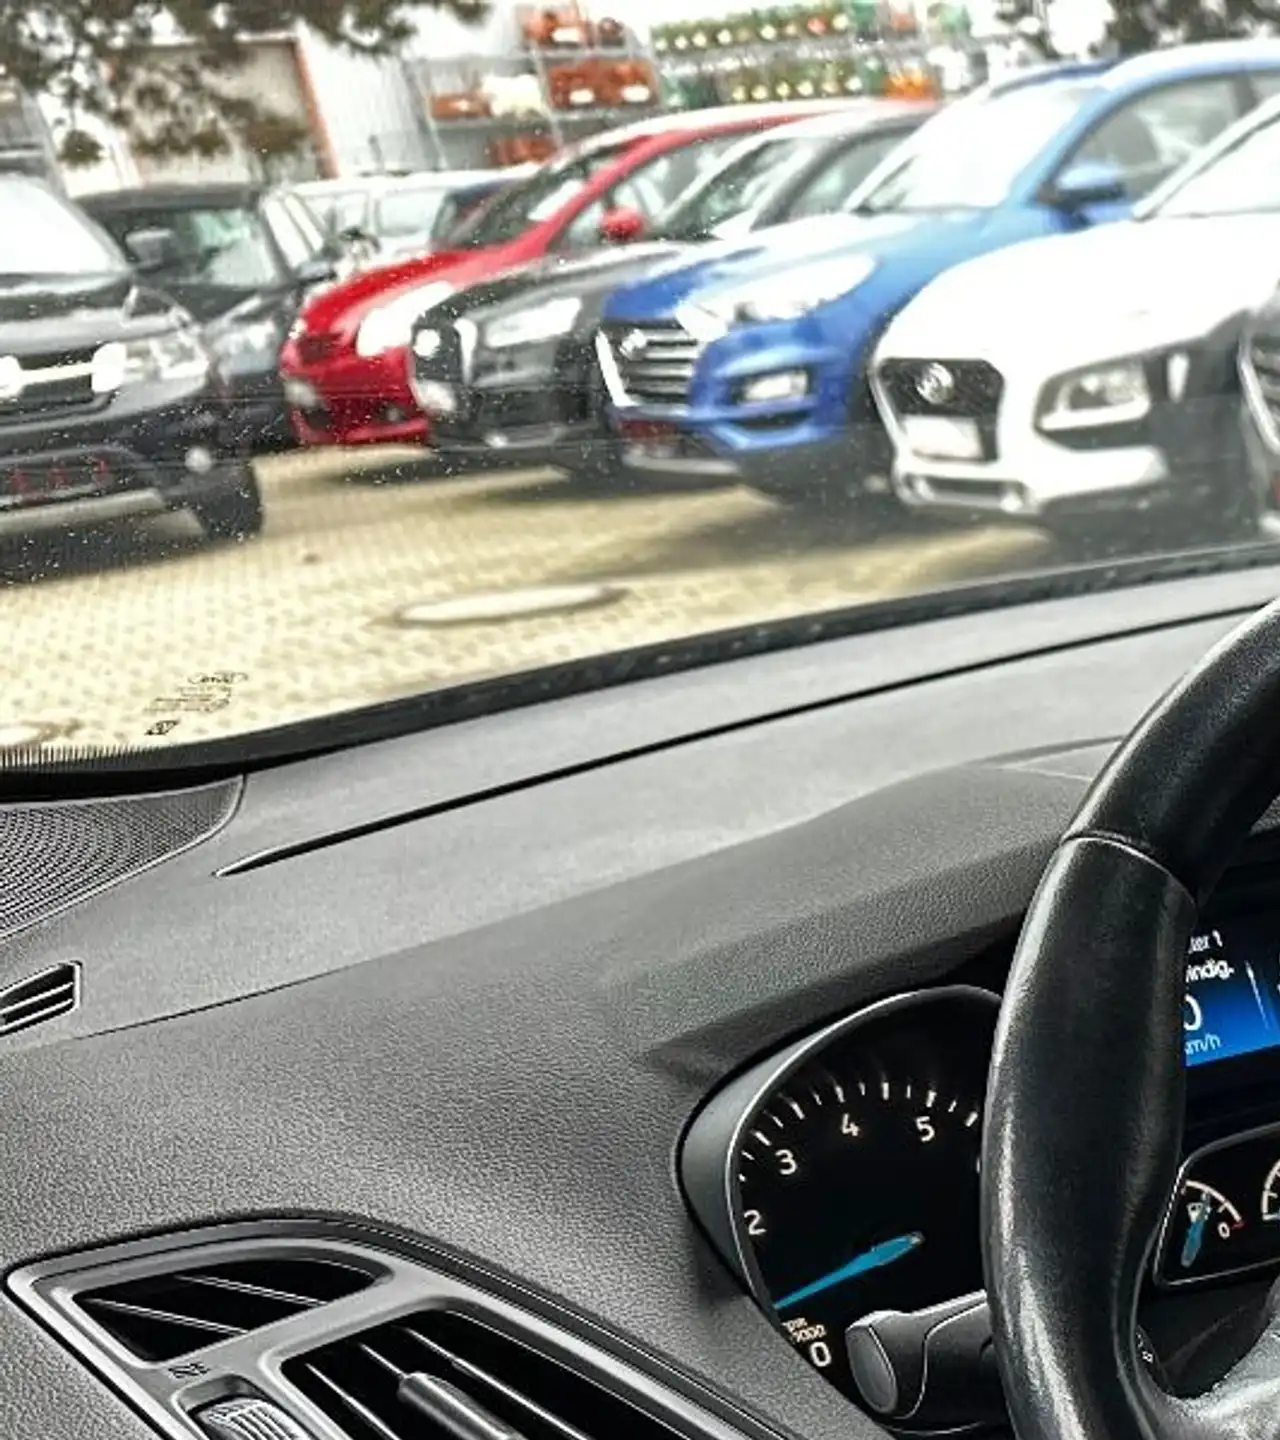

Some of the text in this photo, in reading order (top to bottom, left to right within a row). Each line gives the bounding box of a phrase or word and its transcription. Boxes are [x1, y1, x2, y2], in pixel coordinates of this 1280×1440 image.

[841, 1113, 860, 1136] 4
[915, 1116, 935, 1142] 5
[774, 1149, 799, 1175] 3
[743, 1209, 766, 1236] 2
[1217, 1221, 1231, 1240] 0
[810, 1341, 832, 1367] 0
